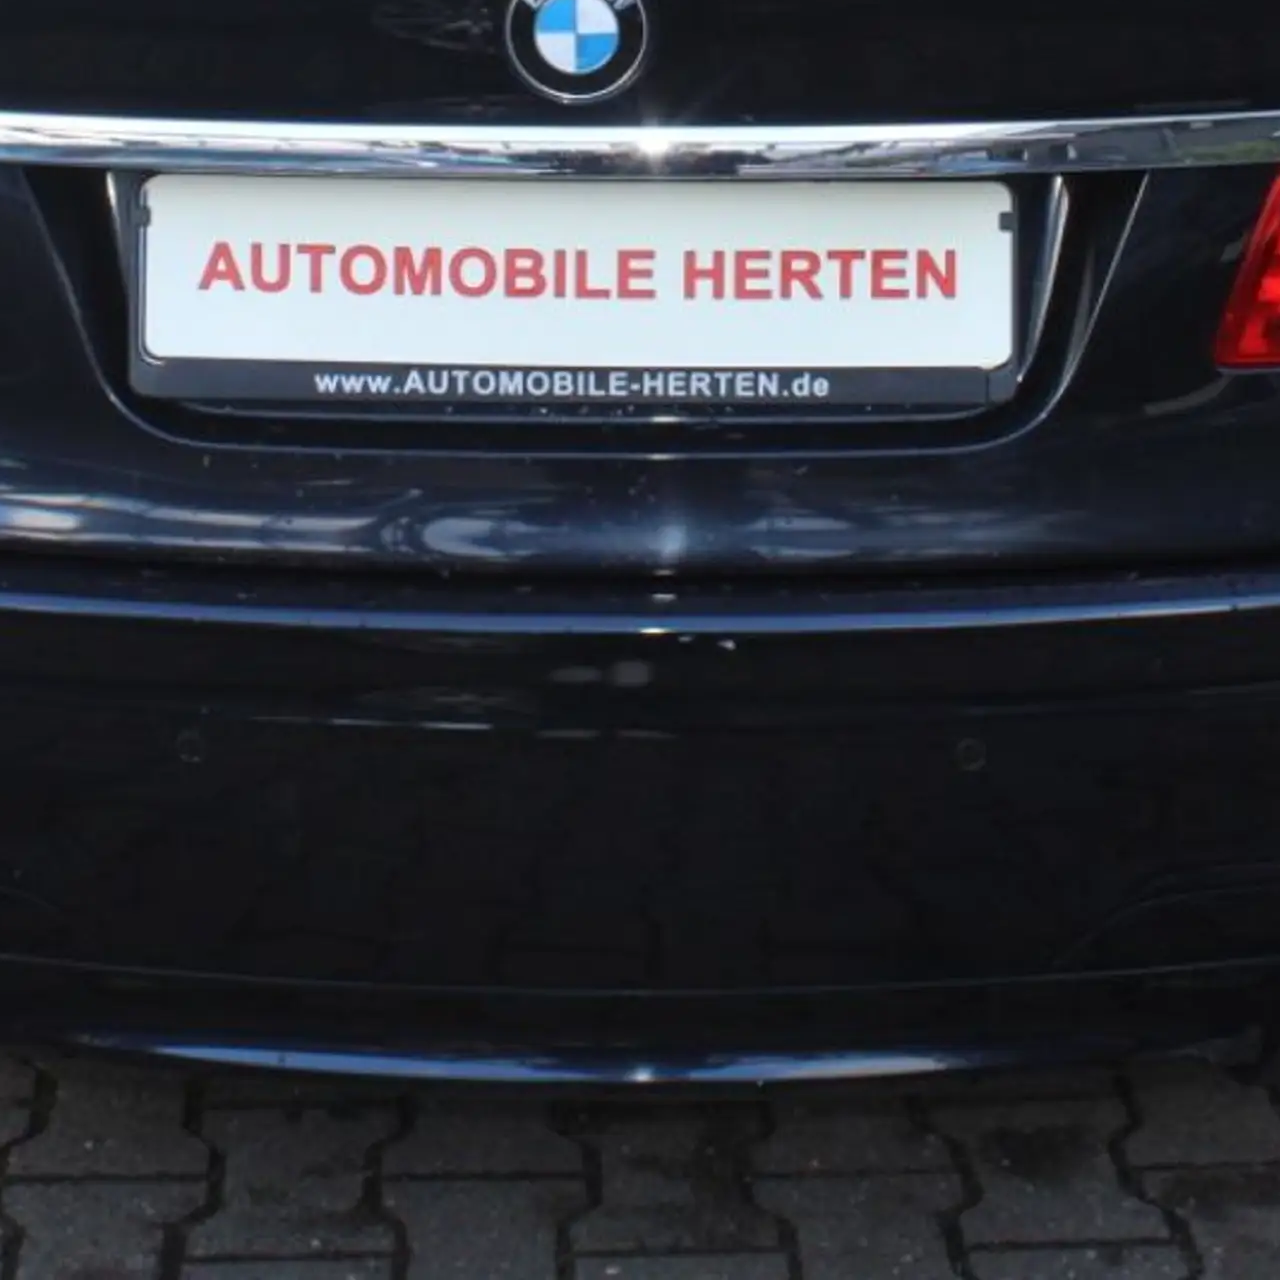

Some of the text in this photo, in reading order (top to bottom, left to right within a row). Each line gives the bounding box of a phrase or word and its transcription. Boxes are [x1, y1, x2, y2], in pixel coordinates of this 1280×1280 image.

[198, 241, 957, 300] AUTOMOBILE HERTEN
[314, 369, 830, 398] www.AUTOMOBILE-HERTEN.de
